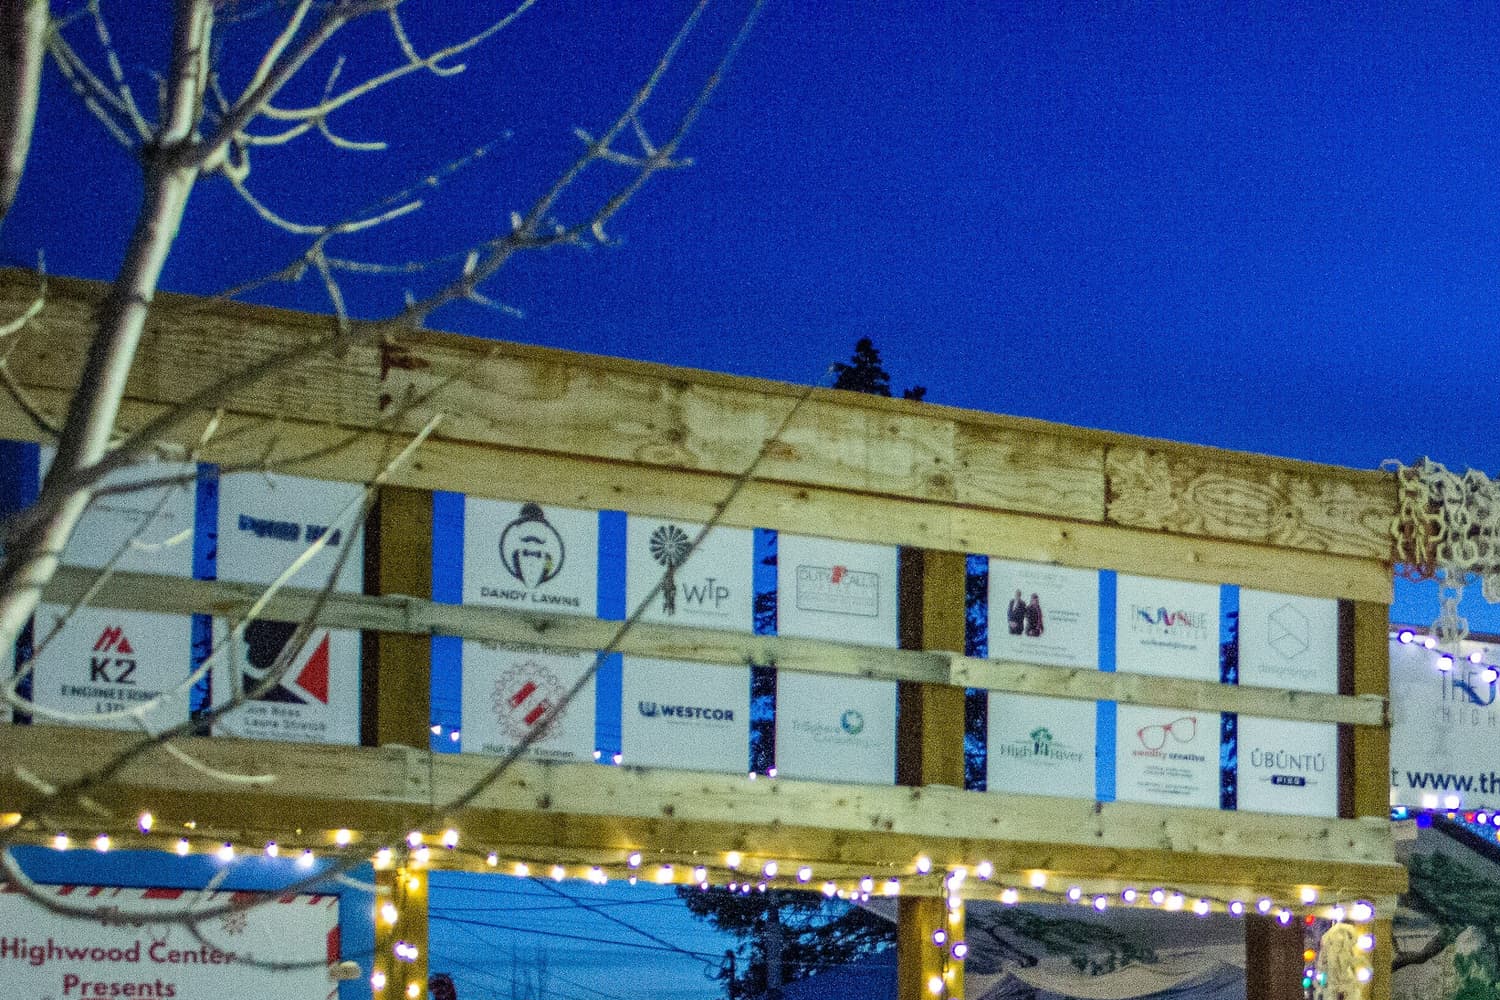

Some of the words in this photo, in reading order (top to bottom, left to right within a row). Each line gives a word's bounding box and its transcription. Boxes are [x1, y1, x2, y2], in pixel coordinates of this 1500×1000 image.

[481, 587, 527, 602] DANDY
[532, 593, 580, 607] LAWNS
[89, 656, 137, 685] K2
[661, 704, 735, 721] WESTCOR
[1000, 743, 1031, 759] High
[1049, 747, 1083, 763] River
[1, 937, 141, 966] Highwood
[62, 973, 177, 998] Presents
